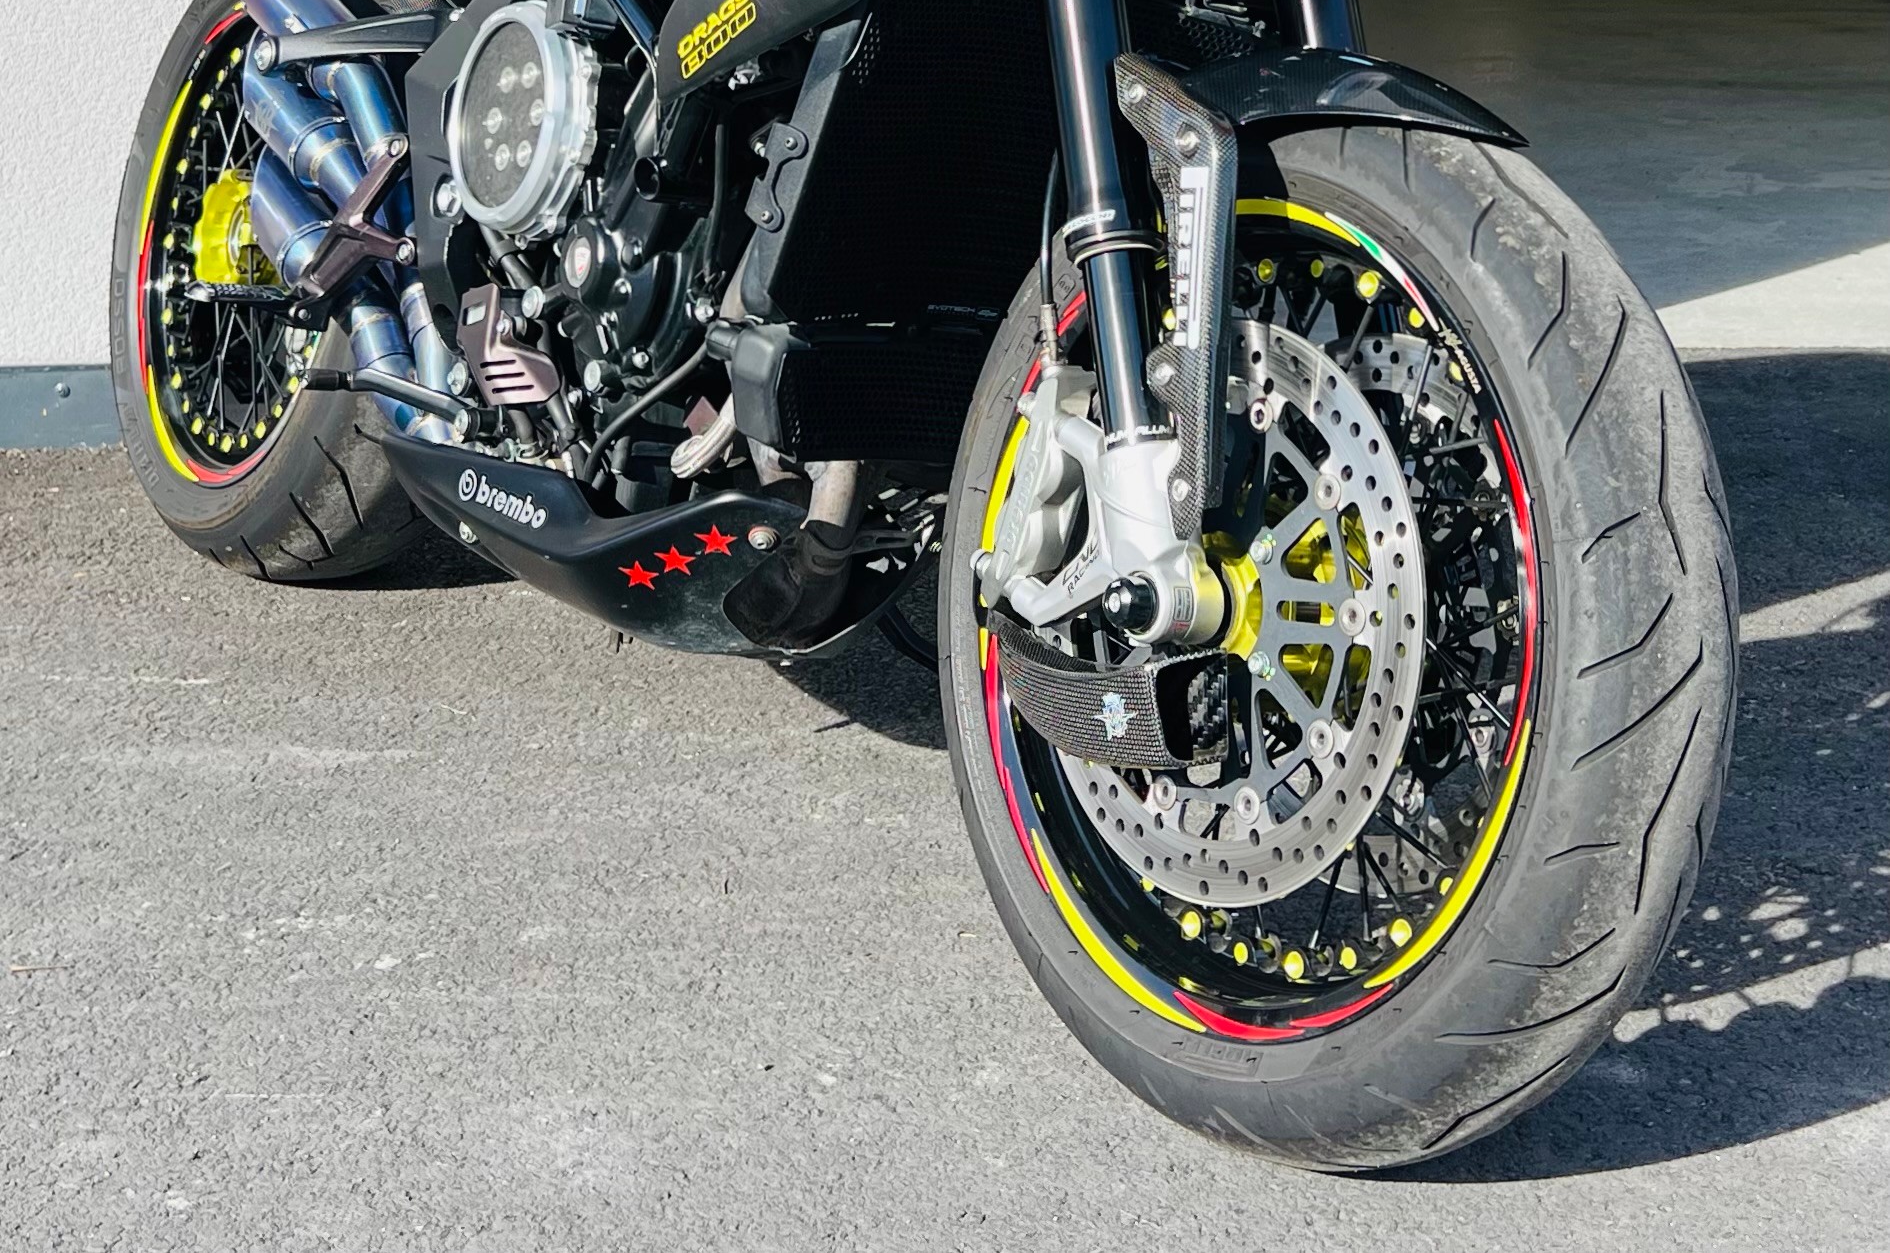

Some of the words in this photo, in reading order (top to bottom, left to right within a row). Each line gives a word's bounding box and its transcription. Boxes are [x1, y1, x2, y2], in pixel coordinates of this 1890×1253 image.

[681, 1, 757, 80] 800
[1457, 350, 1482, 394] AGUSTA
[475, 475, 549, 530] brembo
